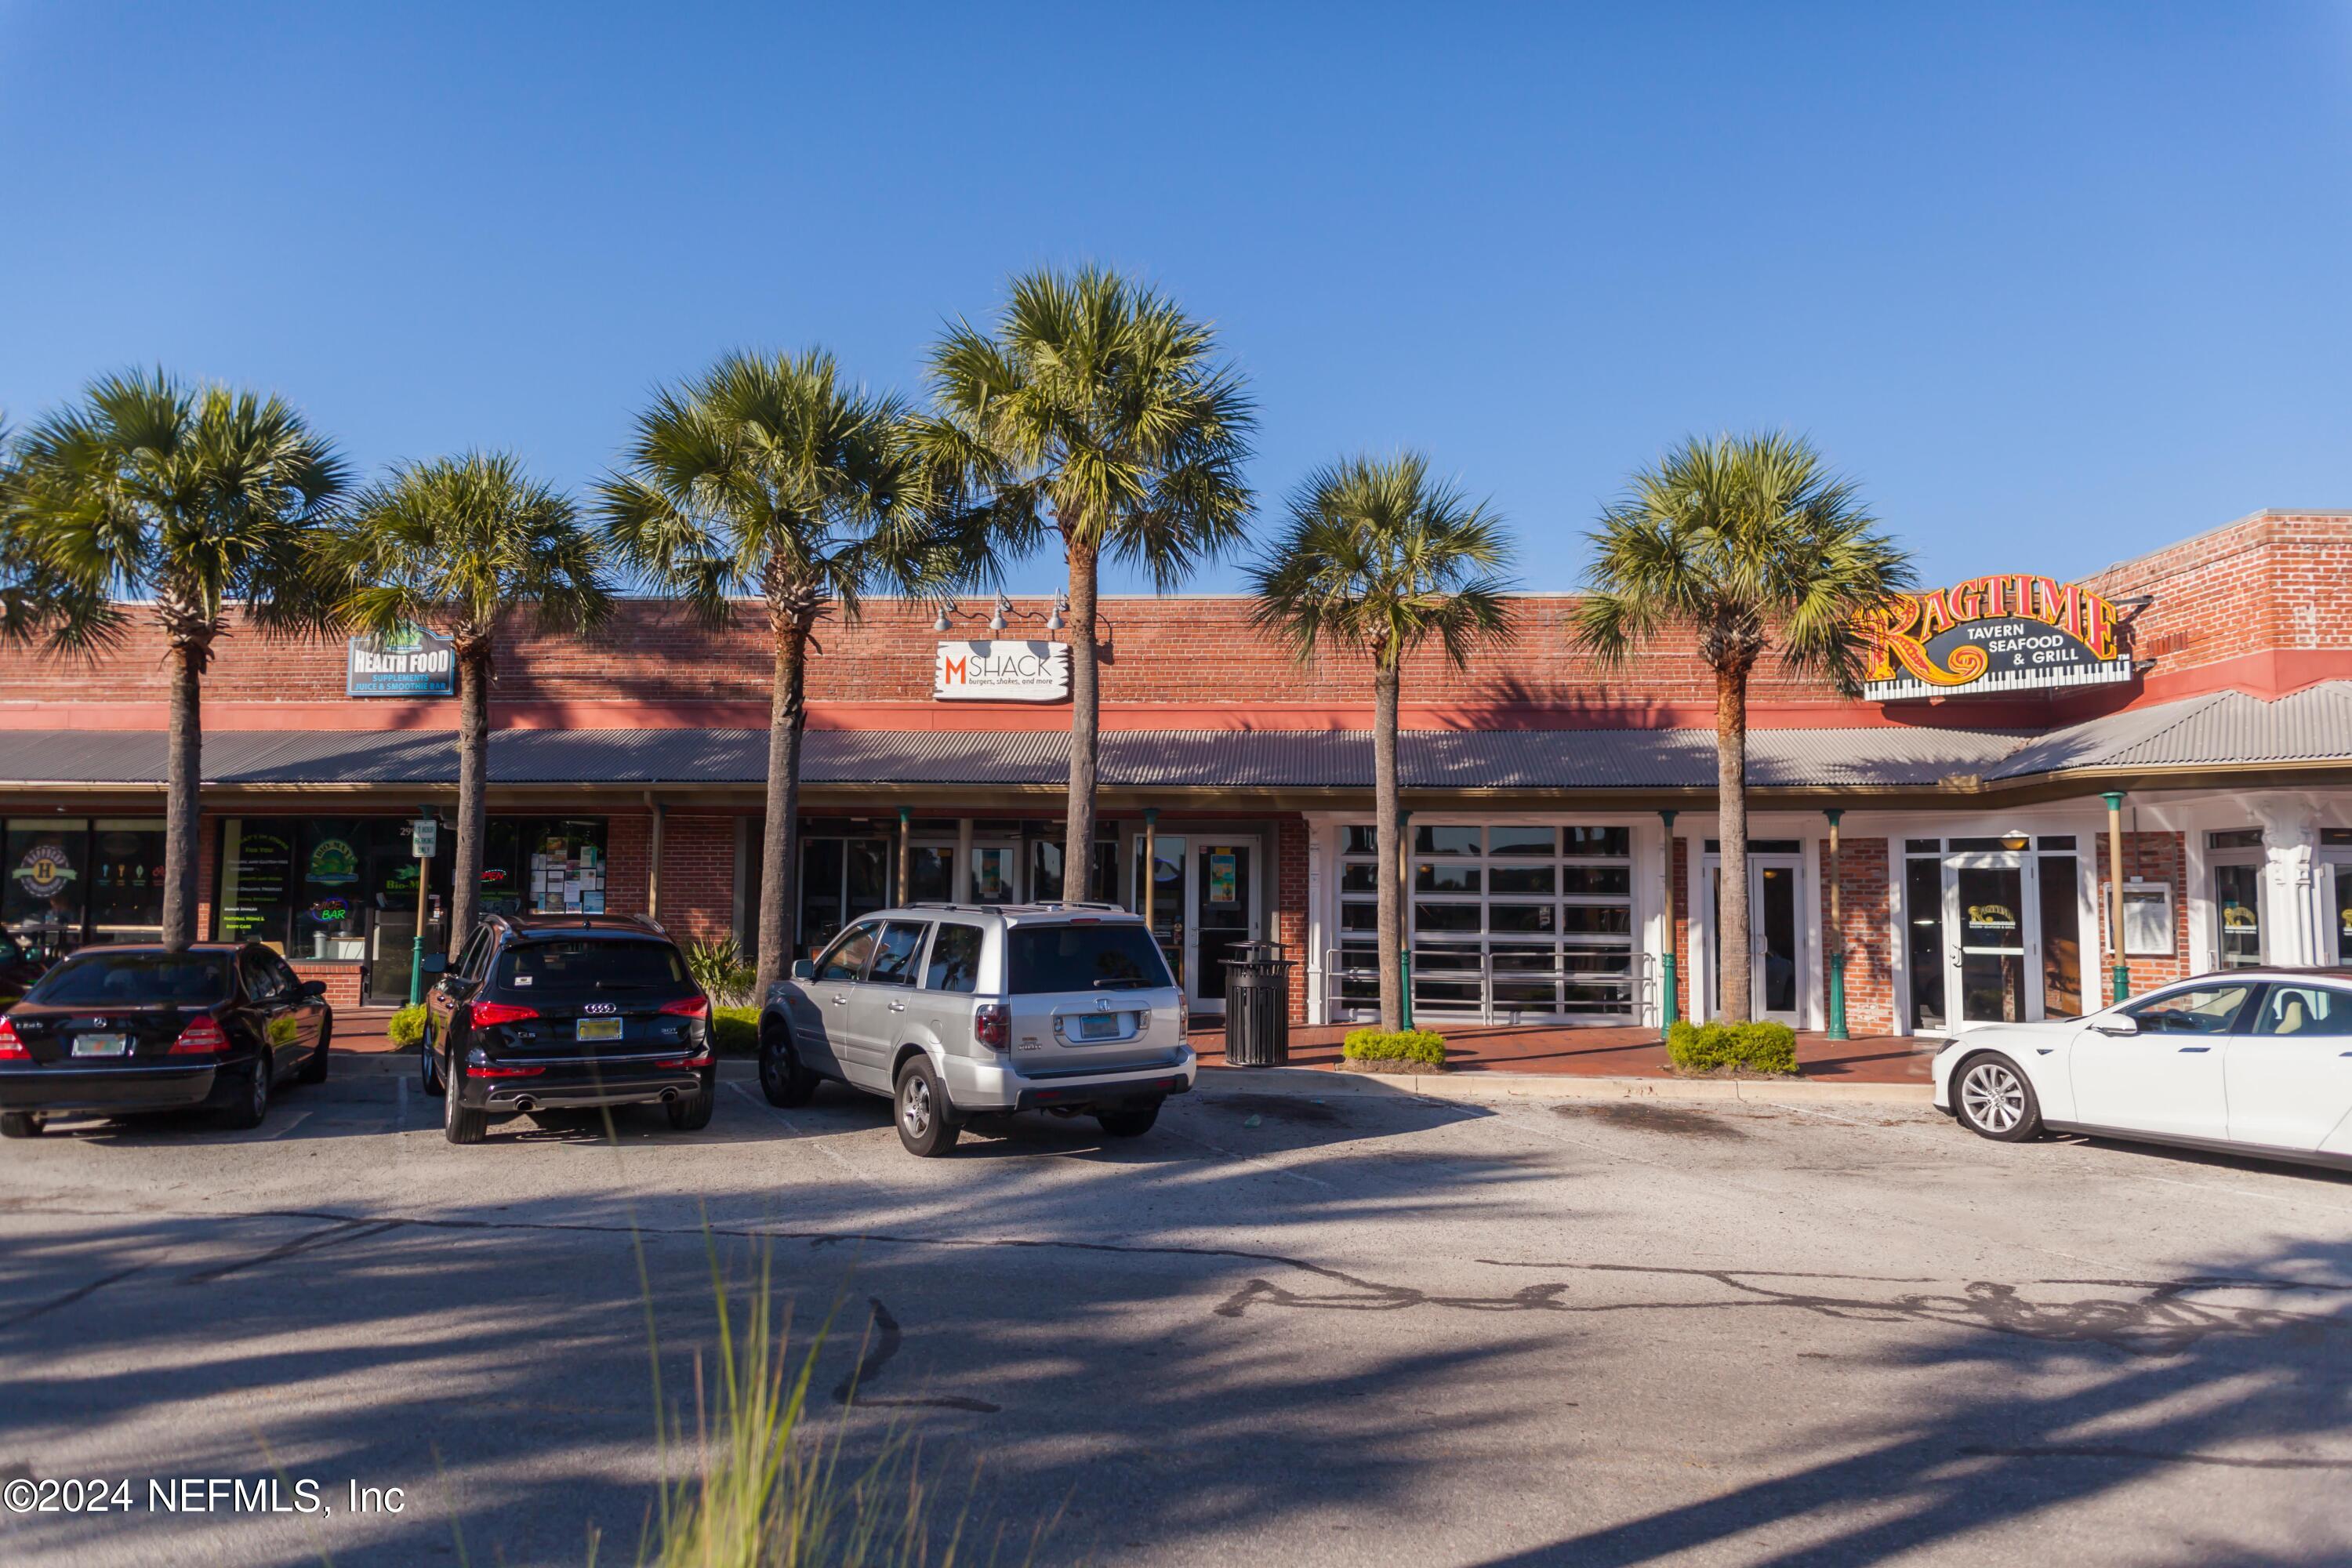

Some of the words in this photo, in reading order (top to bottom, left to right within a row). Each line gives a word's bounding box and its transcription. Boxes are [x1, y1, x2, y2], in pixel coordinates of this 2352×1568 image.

[1850, 574, 2117, 685] RAGTIME
[1968, 624, 2024, 640] TAVERN
[1989, 635, 2063, 652] SEAFOOD
[354, 649, 407, 673] HEALTH
[410, 649, 449, 673] FOOD
[2013, 653, 2024, 665] &
[2032, 648, 2078, 663] GRILL
[946, 655, 966, 684] M
[969, 655, 1051, 677] SHACK
[38, 863, 51, 878] H
[322, 909, 345, 919] BAR
